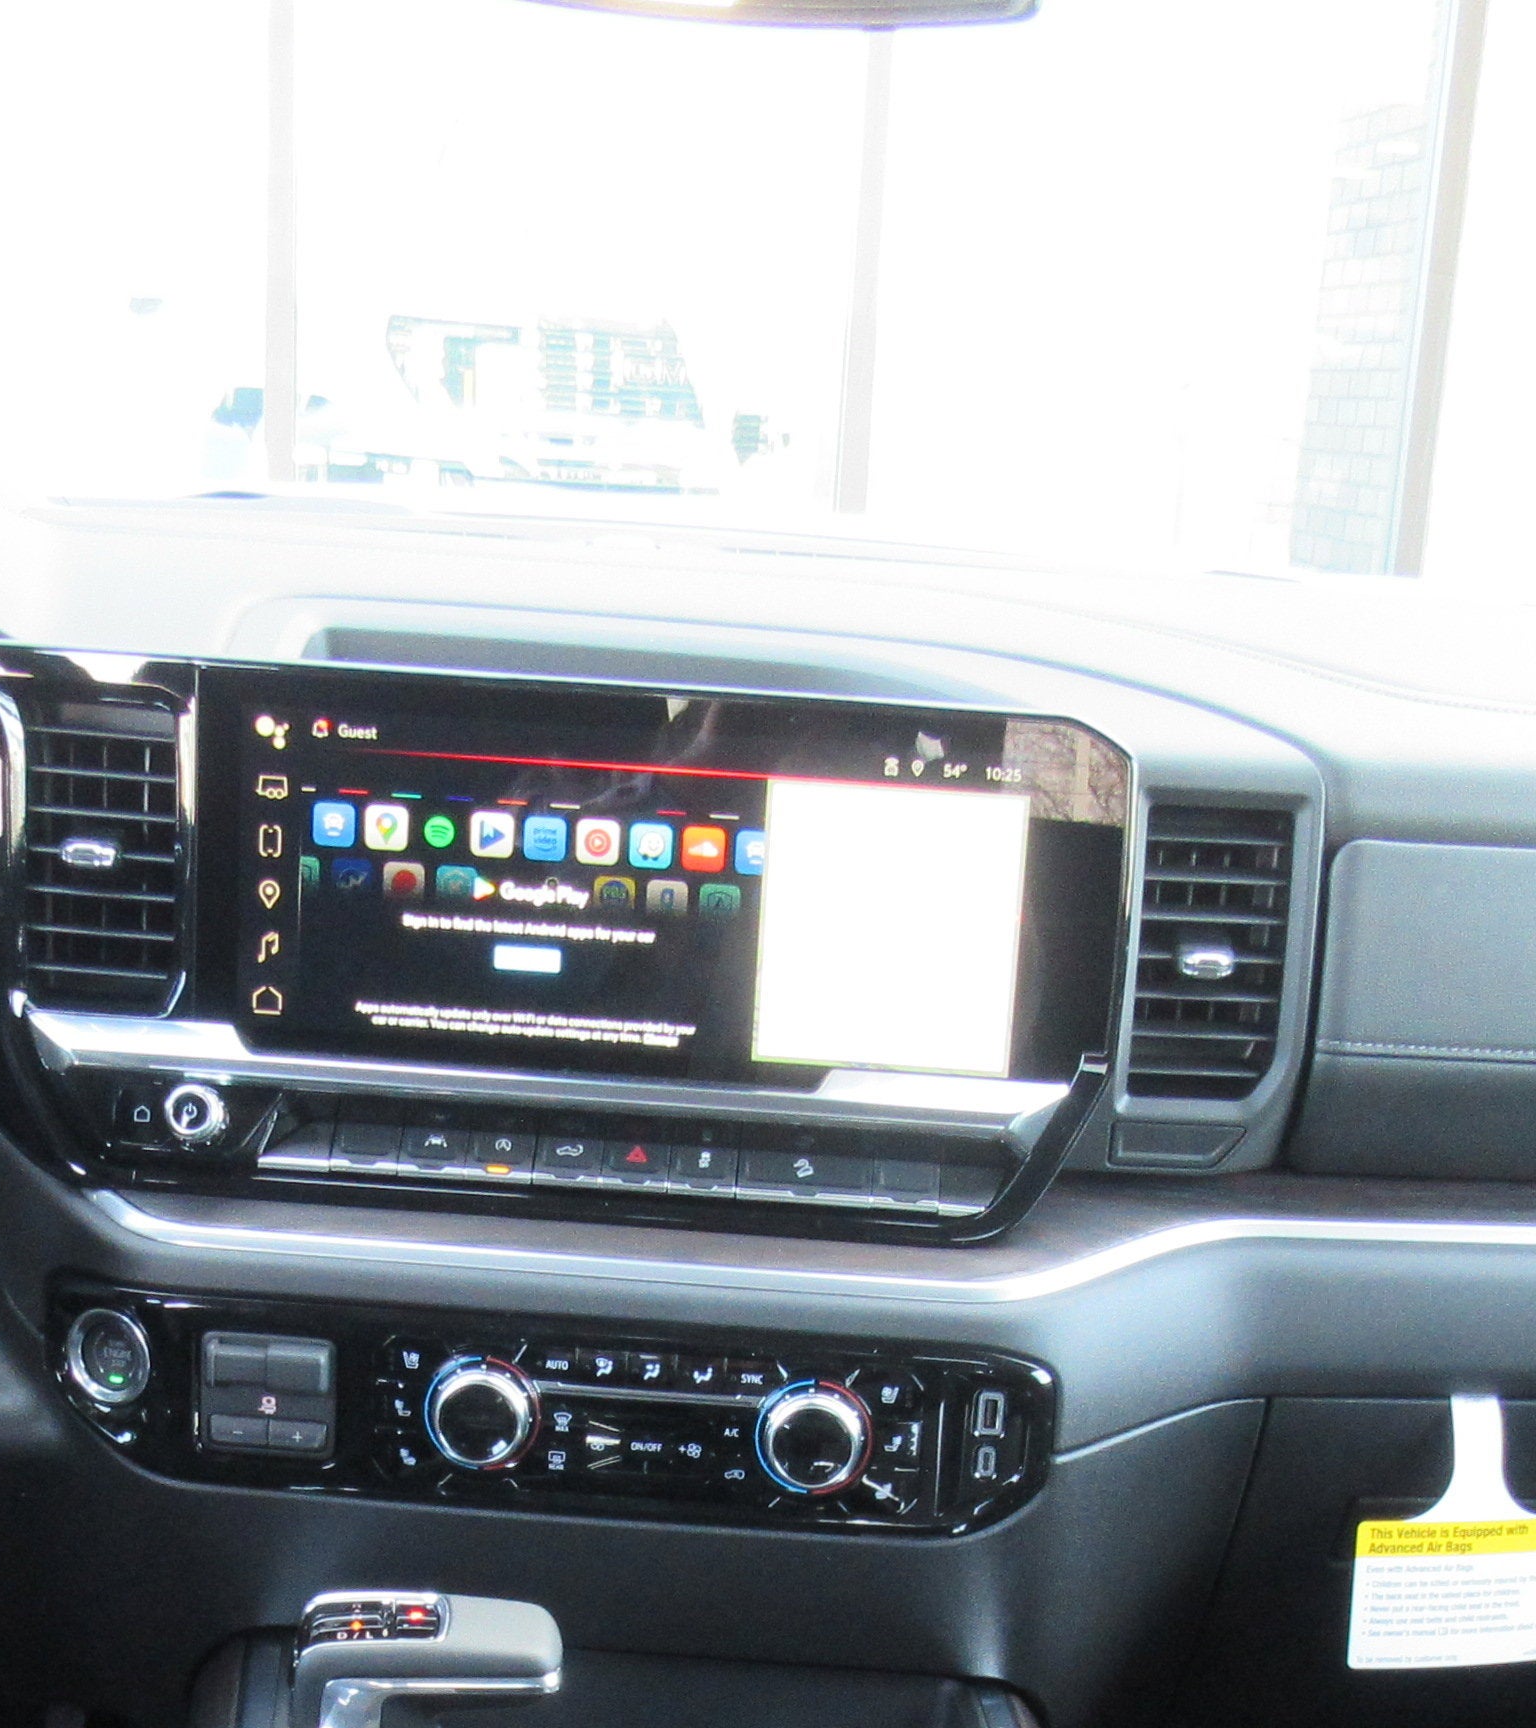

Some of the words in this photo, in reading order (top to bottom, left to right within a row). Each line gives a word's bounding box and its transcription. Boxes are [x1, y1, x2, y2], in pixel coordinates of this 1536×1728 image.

[338, 723, 378, 740] Guest
[985, 766, 1022, 782] 10:25
[500, 881, 556, 906] Google
[556, 885, 589, 909] Play
[403, 913, 427, 929] Sign
[525, 922, 566, 937] Android
[567, 927, 594, 940] apps
[595, 926, 611, 940] for
[612, 930, 636, 943] your
[637, 932, 655, 943] car
[380, 1004, 439, 1019] automatically
[440, 1008, 471, 1020] update
[472, 1010, 491, 1022] only
[623, 1020, 663, 1033] provided
[675, 1025, 696, 1036] your
[430, 1018, 448, 1029] You
[449, 1021, 466, 1031] can
[467, 1021, 500, 1034] change
[545, 1360, 569, 1371] AUTO
[740, 1374, 764, 1385] SYNC
[723, 1428, 740, 1438] A/C
[630, 1441, 663, 1453] ON/OFF
[1370, 1527, 1393, 1539] This
[1397, 1526, 1437, 1539] Vehicle
[1440, 1526, 1449, 1538] is
[1453, 1524, 1503, 1541] Equipped
[1505, 1523, 1529, 1536] with
[1368, 1541, 1424, 1553] Advanced
[1426, 1541, 1441, 1552] Air
[1445, 1541, 1473, 1554] Bags
